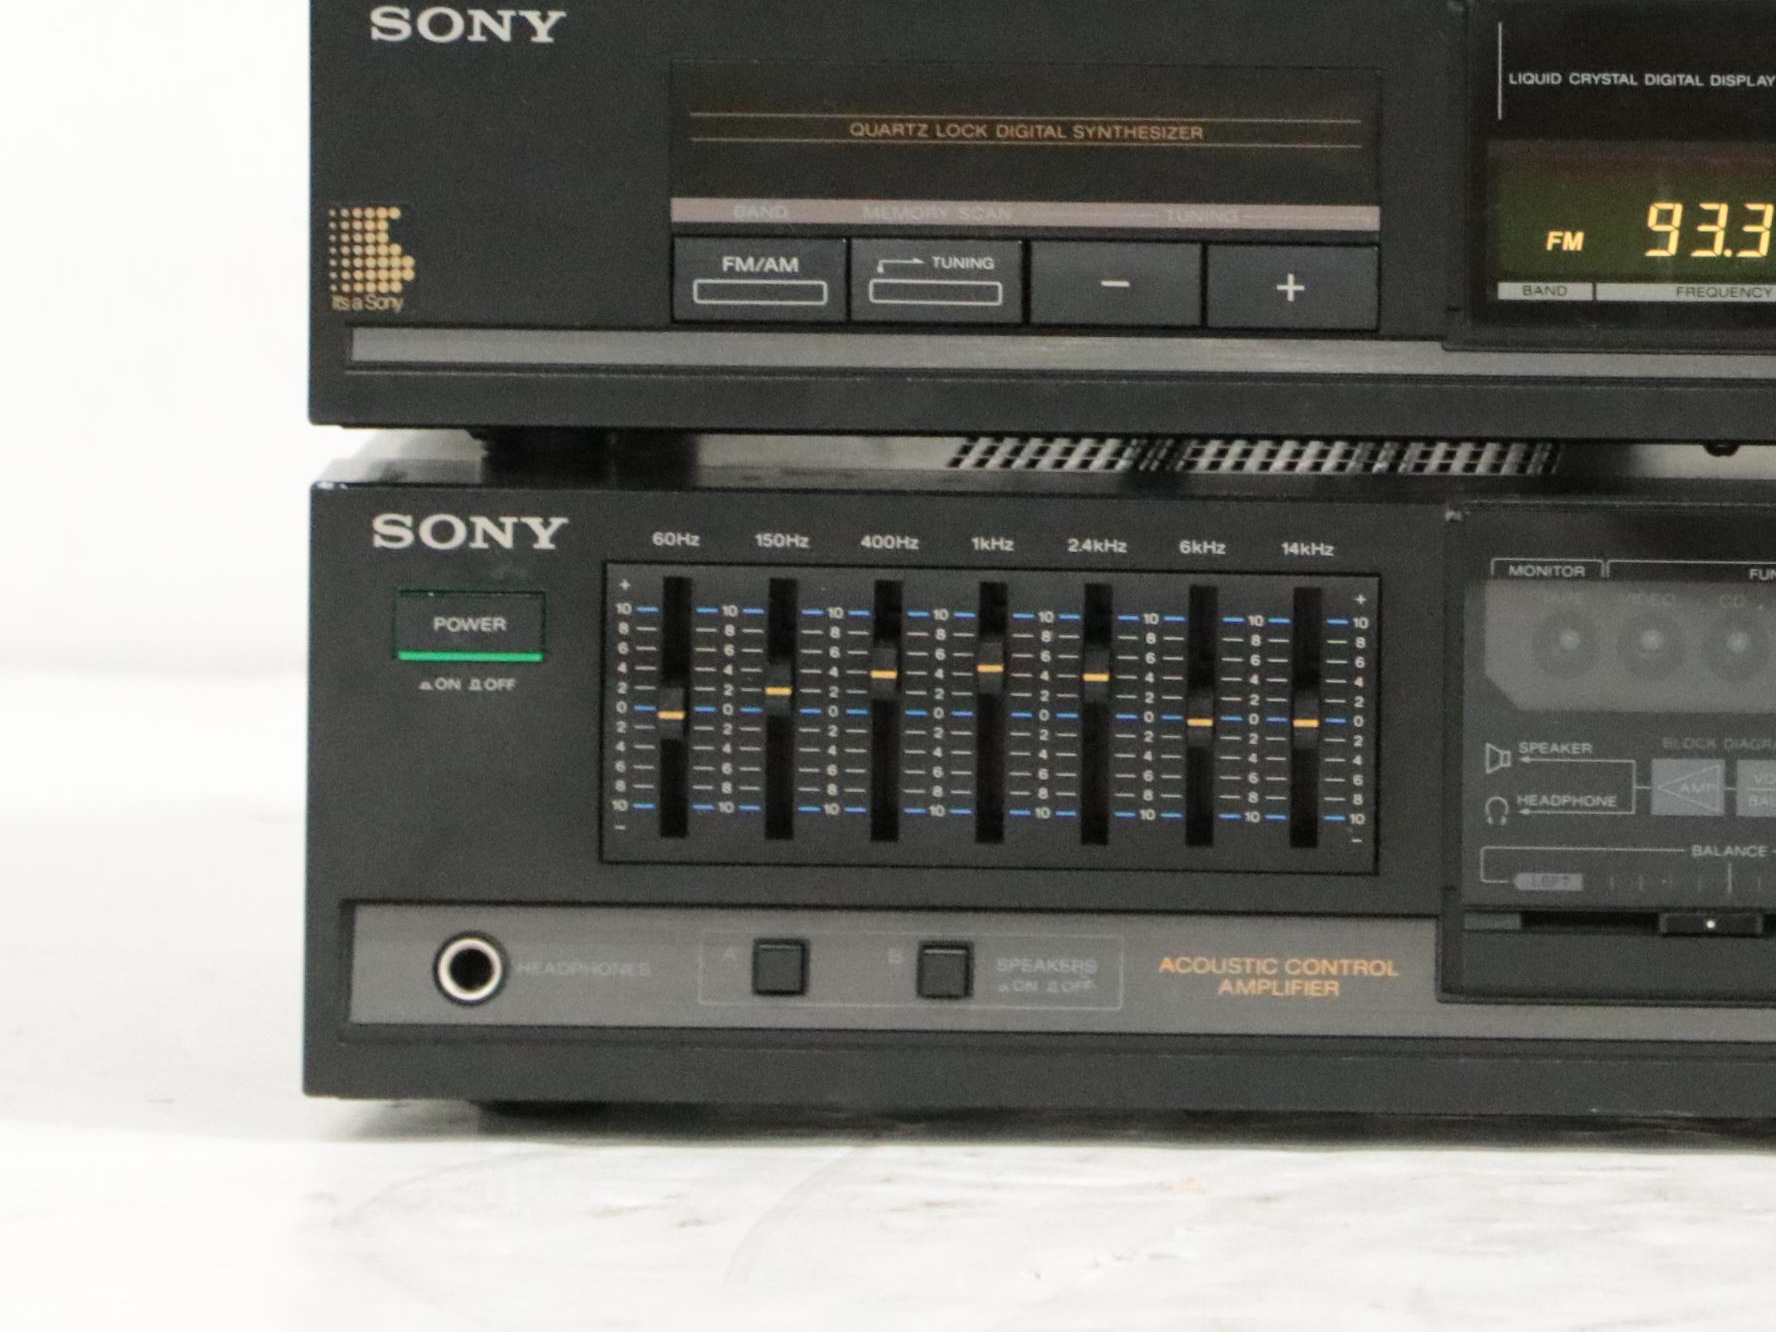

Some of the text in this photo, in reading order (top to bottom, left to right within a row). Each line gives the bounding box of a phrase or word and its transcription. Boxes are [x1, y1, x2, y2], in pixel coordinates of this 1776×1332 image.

[369, 6, 566, 43] SONY
[1509, 73, 1776, 88] LIQUID CRYSTAL DIGITAL DISPLAY
[850, 122, 1204, 141] QUARTZ LOCK DIGITAL SYNTHESIZER
[734, 205, 788, 219] BAND
[958, 206, 1012, 222] SCAN
[1645, 202, 1775, 258] 93.3
[1546, 232, 1584, 251] FM
[722, 256, 799, 273] FM/AM
[932, 255, 994, 269] TUNING
[1522, 286, 1567, 297] BAND
[1677, 286, 1772, 299] FREQUENCY
[372, 513, 569, 550] SONY
[652, 532, 700, 547] 60Hz
[756, 534, 809, 549] 150Hz
[860, 536, 919, 550] 400Hz
[972, 538, 1014, 551] 1kHz
[1068, 539, 1127, 553] 2.4kHz
[1179, 540, 1226, 554] 6kHz
[1281, 542, 1334, 556] 14kHz
[1508, 565, 1585, 577] MONITOR
[433, 617, 507, 632] POWER
[435, 678, 516, 690] ON OFF
[1519, 742, 1593, 754] SPEAKER
[1663, 737, 1716, 749] BLOCK
[1517, 795, 1616, 808] HEADPHONE
[1691, 845, 1767, 858] BALANCE
[997, 957, 1098, 973] SPEAKERS
[1159, 957, 1398, 977] ACOUSTIC CONTROL
[1218, 979, 1340, 997] AMPLIFIER
